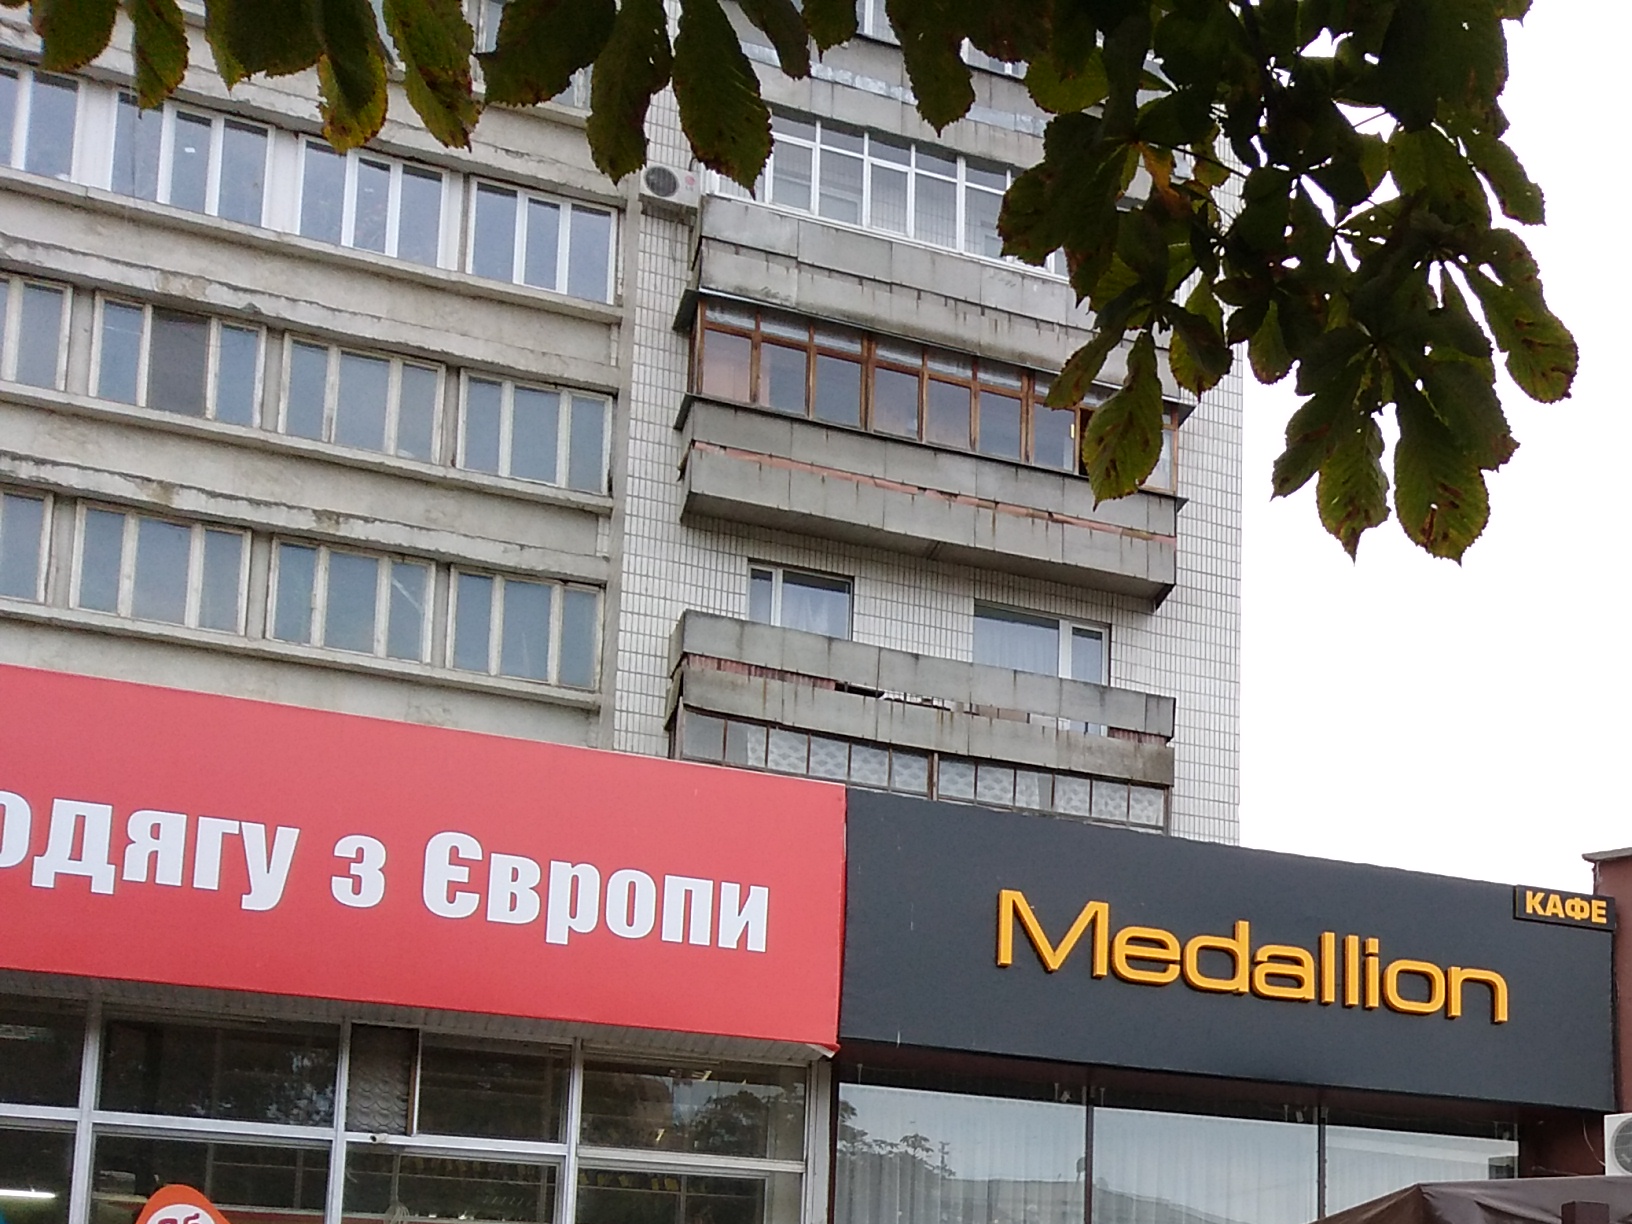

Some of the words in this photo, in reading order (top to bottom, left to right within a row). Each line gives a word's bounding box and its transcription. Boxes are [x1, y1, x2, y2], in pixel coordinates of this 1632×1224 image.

[331, 834, 386, 908] з
[422, 831, 769, 953] Європи
[1525, 890, 1608, 924] КАФЕ
[997, 888, 1509, 1023] Medallion
